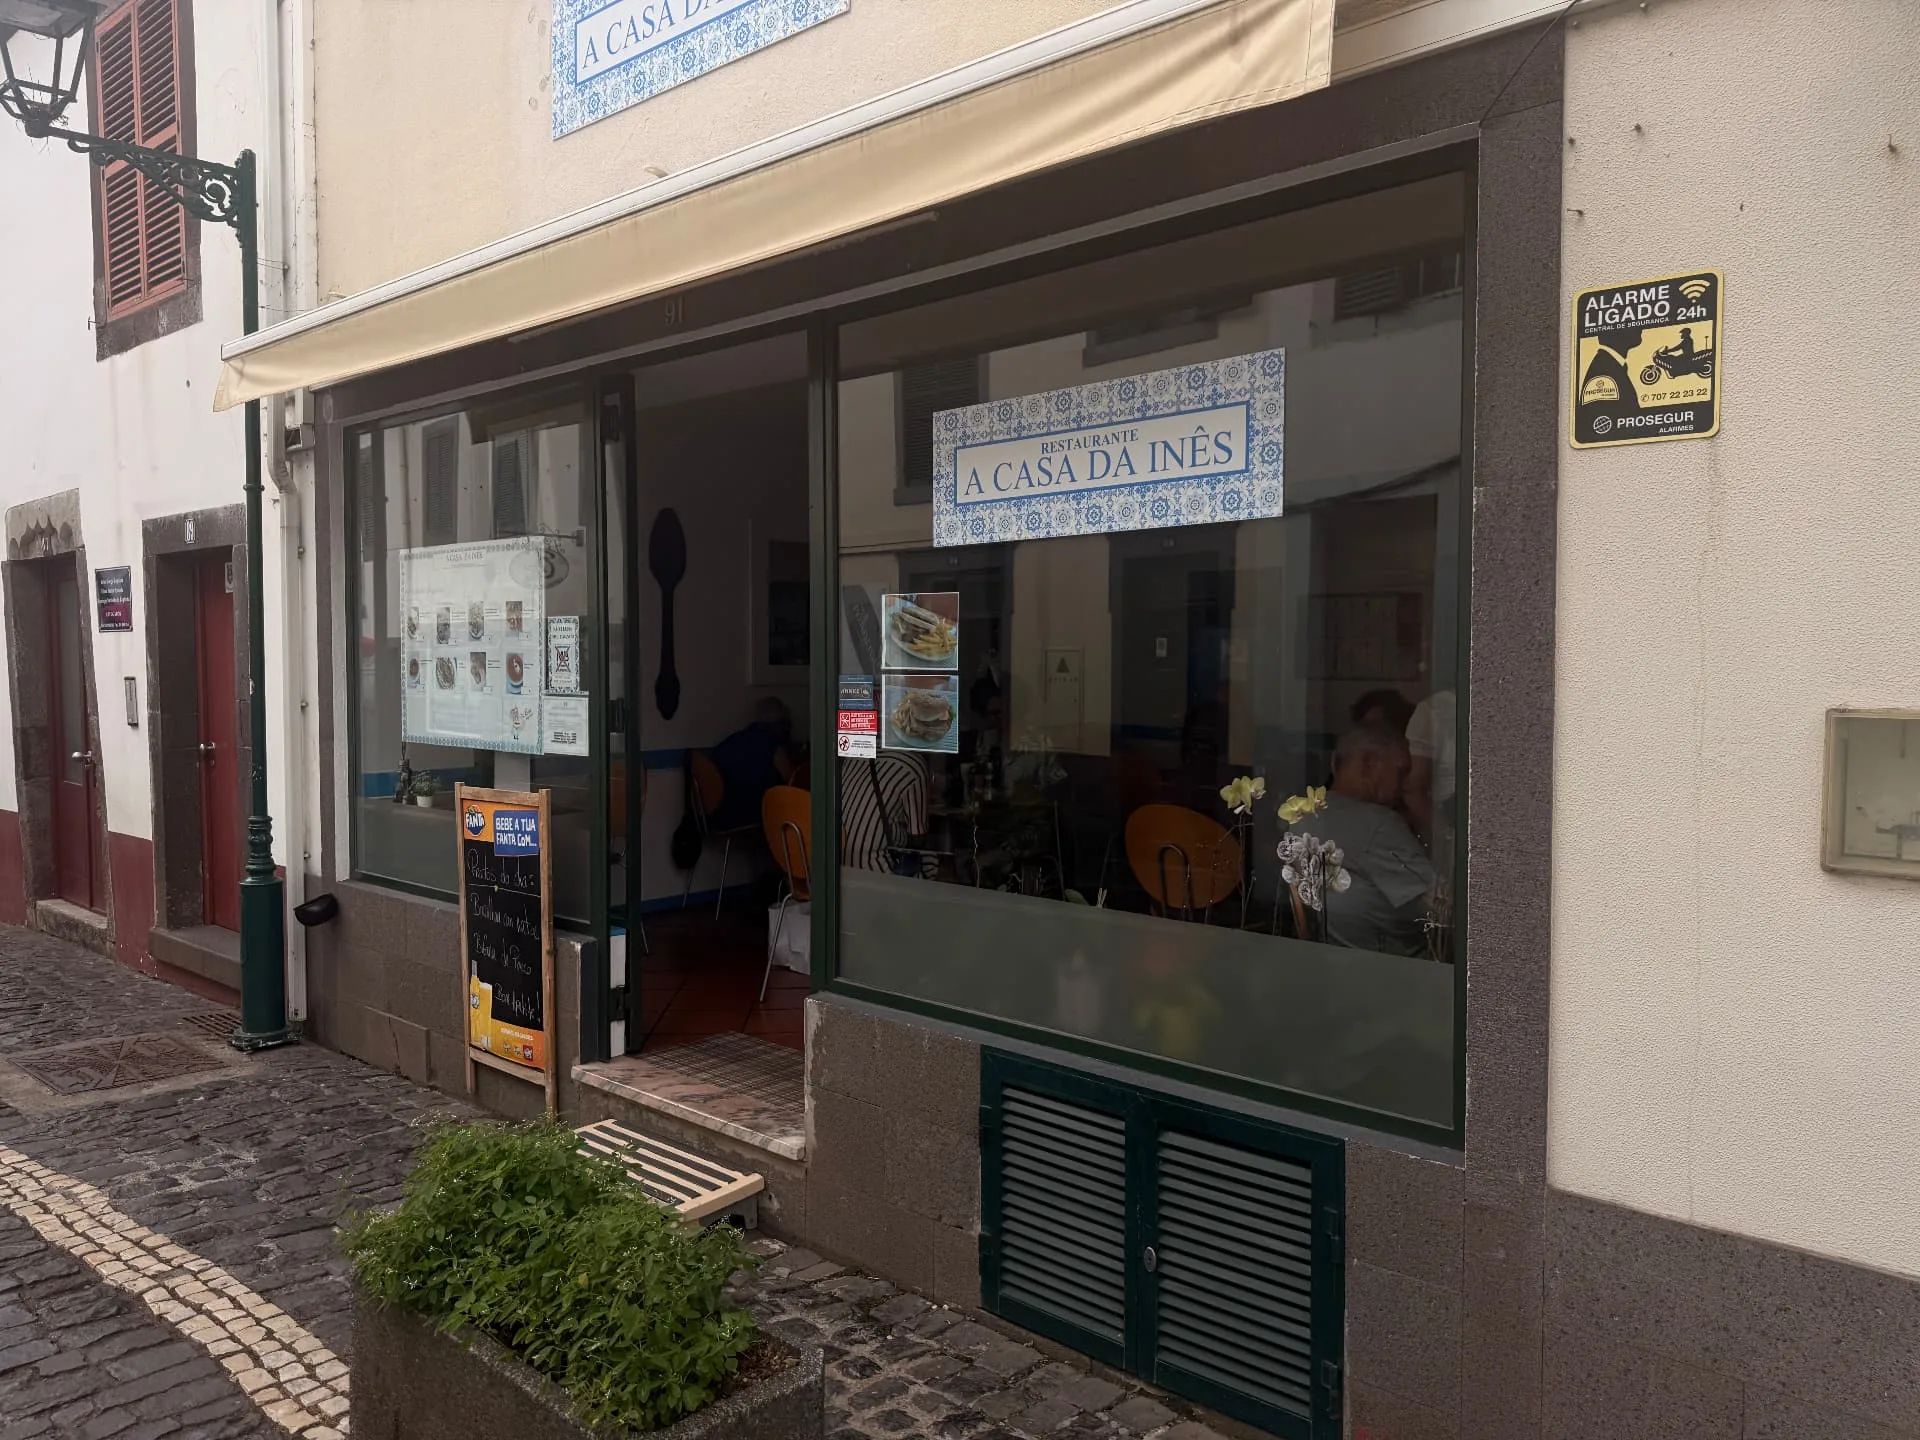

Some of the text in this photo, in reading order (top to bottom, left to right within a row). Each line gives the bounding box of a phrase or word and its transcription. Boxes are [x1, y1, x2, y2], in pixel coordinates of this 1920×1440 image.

[582, 0, 722, 69] A CASA D
[1586, 284, 1670, 311] ALARME
[1585, 300, 1670, 327] LIGADO
[1676, 305, 1707, 321] 24h
[1584, 326, 1615, 334] CENTRAL
[1651, 388, 1708, 401] 707 22 23 22
[1617, 411, 1694, 429] PROSEGUR
[1659, 425, 1694, 434] ALARMES
[1041, 428, 1139, 455] RESTAURANTE
[964, 425, 1233, 496] A CASA DA INÊS
[465, 812, 485, 828] FANTA
[495, 817, 536, 832] BEBE A TUA
[496, 833, 516, 846] FANTA
